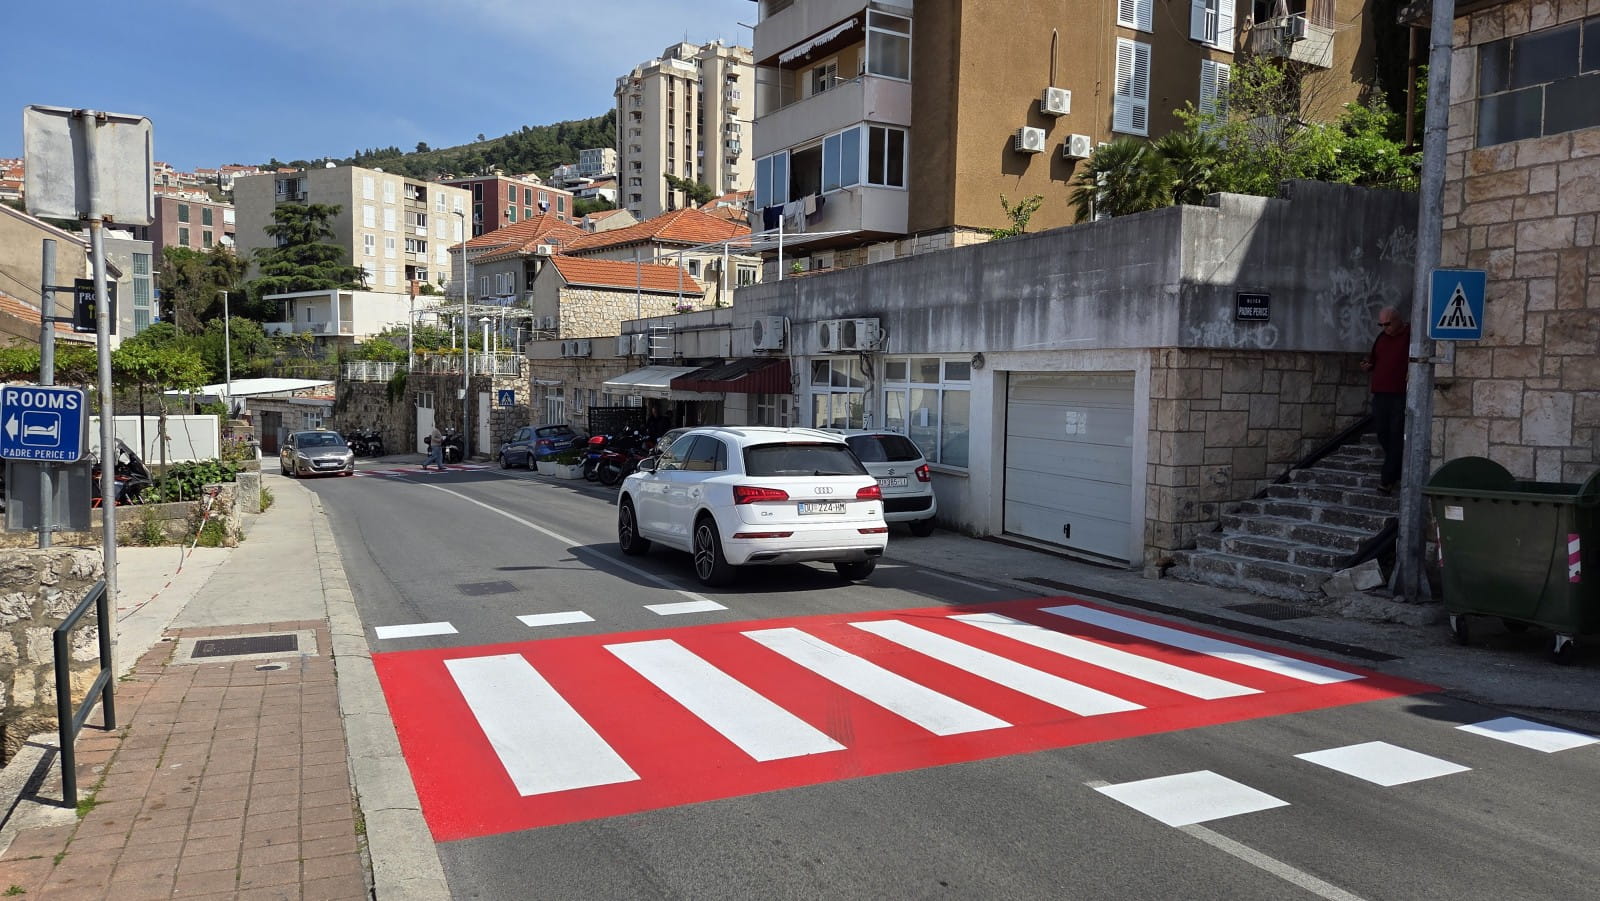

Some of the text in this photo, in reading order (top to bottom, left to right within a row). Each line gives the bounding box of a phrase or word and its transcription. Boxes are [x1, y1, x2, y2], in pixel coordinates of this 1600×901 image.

[6, 390, 78, 410] ROOMS
[3, 448, 76, 460] PADRE PERICE 11
